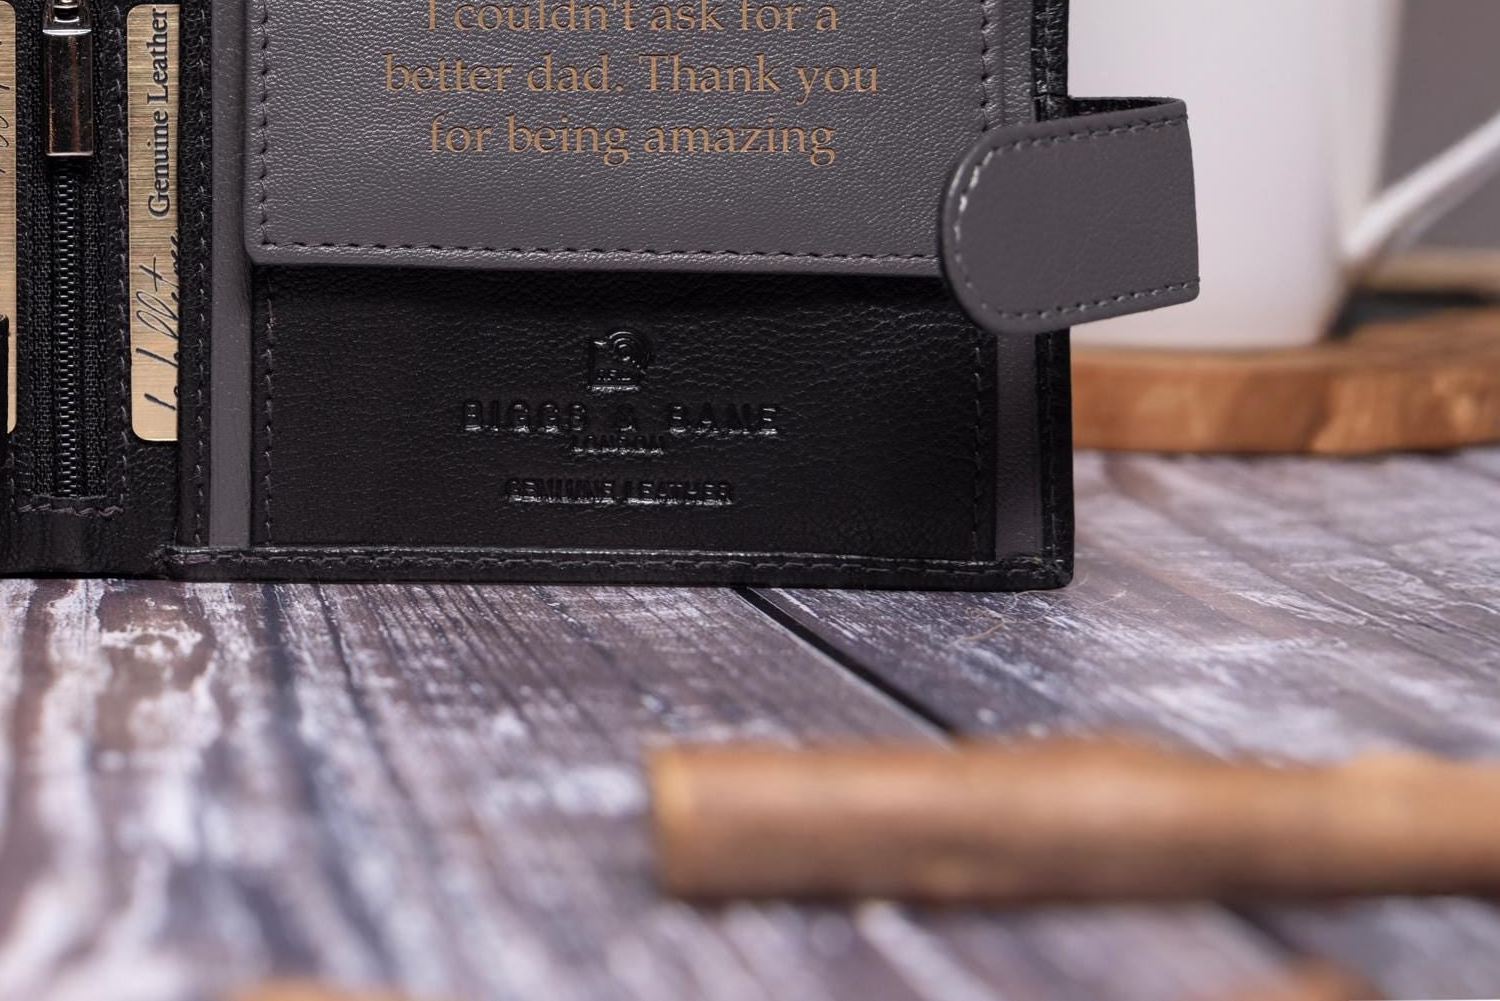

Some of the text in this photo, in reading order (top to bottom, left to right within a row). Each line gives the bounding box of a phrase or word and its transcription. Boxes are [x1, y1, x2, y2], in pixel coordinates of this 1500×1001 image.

[814, 3, 839, 32] a
[146, 5, 170, 103] Leather
[382, 52, 880, 106] better dad. Thank you
[146, 111, 172, 218] Genuine
[429, 113, 838, 167] for being amazing
[504, 478, 735, 506] GENUINE LEATHER
